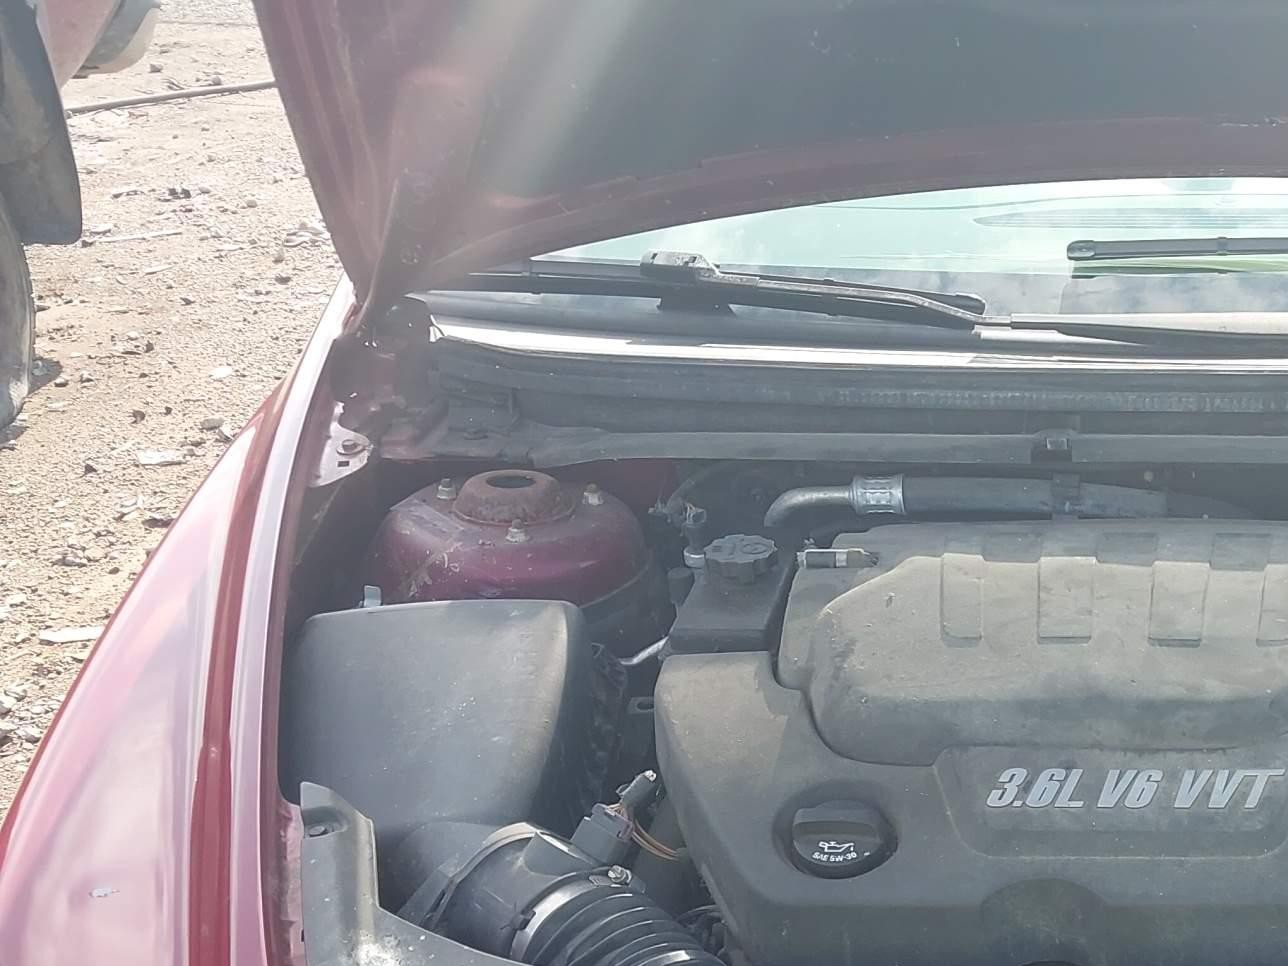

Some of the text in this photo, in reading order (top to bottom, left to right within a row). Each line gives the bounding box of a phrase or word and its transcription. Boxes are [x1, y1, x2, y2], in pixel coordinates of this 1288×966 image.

[986, 767, 1286, 809] 3.6L V6 VVT
[812, 852, 857, 862] SAE 5W-30
